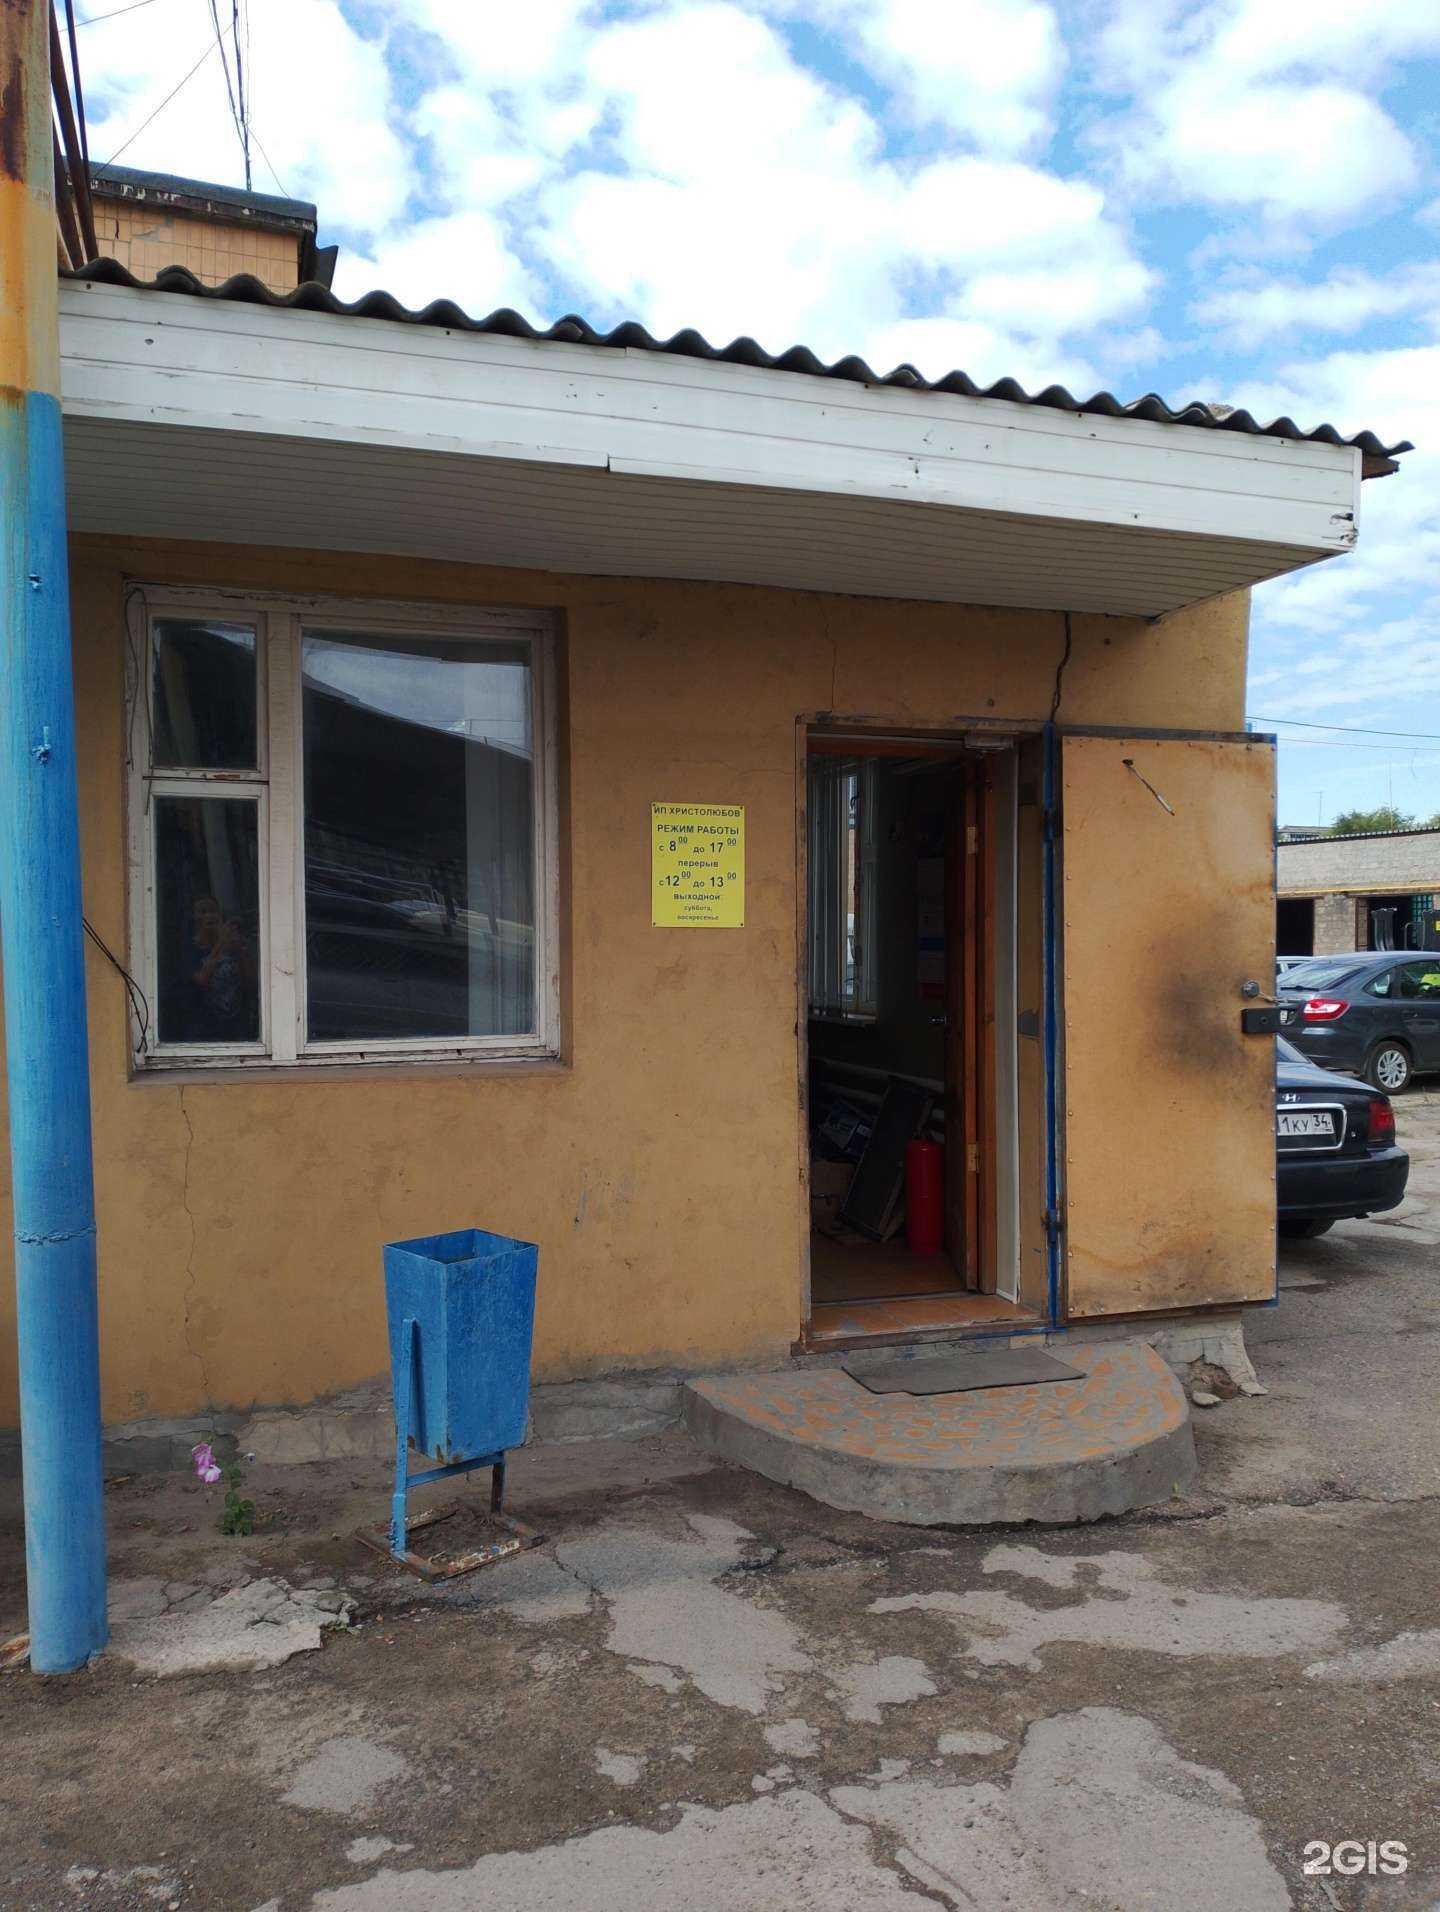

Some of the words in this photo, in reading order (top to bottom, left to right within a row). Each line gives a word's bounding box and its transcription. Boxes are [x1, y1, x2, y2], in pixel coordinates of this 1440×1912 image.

[654, 806, 667, 814] ИП
[669, 806, 740, 817] ХРИСТОЛЮБОВ
[657, 824, 694, 833] РЕЖИМ
[697, 825, 739, 835] РАБОТЫ
[693, 846, 705, 854] до
[678, 860, 719, 869] перерыв
[693, 881, 705, 889] до
[1312, 1114, 1328, 1127] 34
